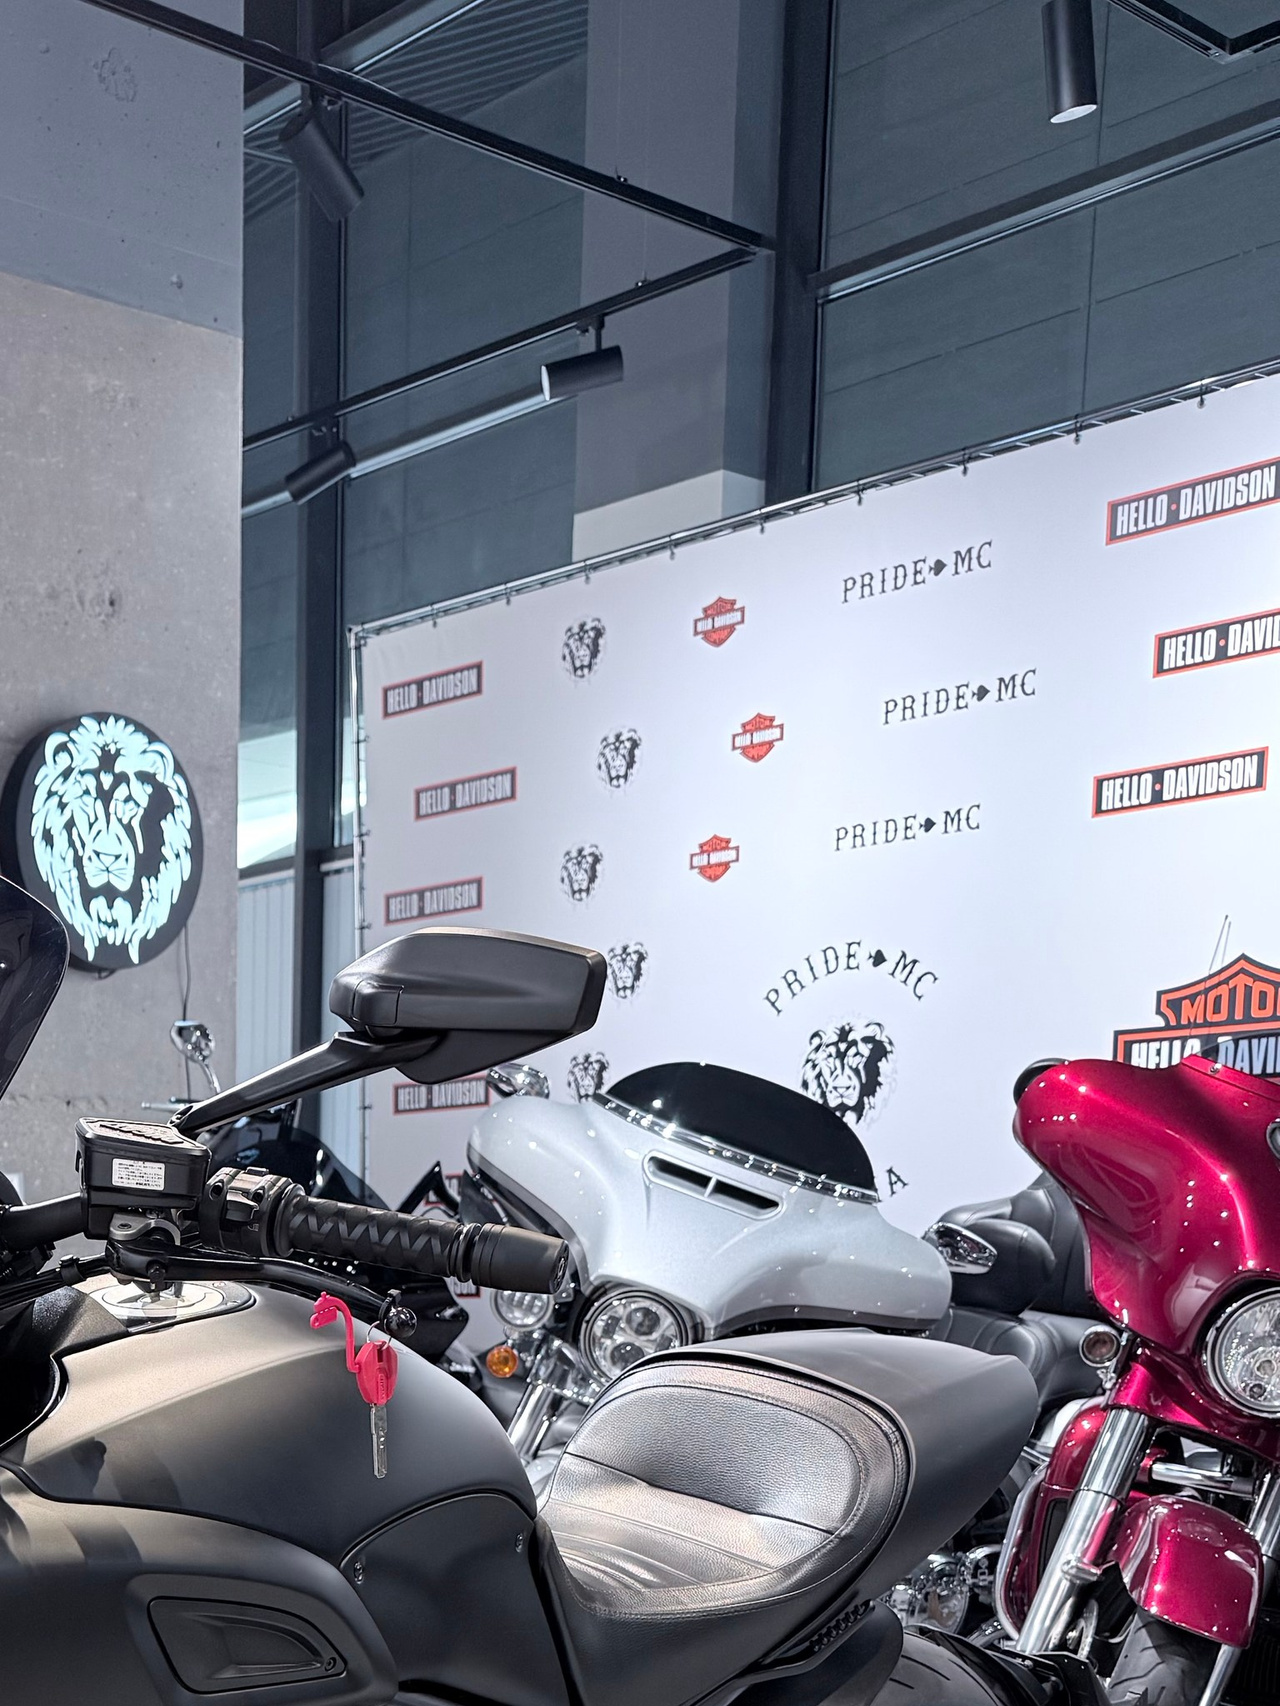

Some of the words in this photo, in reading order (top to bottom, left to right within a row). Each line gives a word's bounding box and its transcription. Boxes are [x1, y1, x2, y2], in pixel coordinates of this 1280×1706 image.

[1116, 494, 1168, 536] HELLO
[1179, 465, 1277, 520] DAVIDSON
[842, 556, 927, 604] PRIDE
[952, 539, 992, 577] MC
[1163, 629, 1217, 669] HELLO
[387, 683, 418, 714] HELLO
[422, 667, 478, 705] DAVIDSON
[883, 681, 970, 725] PRIDE
[995, 668, 1037, 702] MC
[419, 787, 451, 816] HELLO
[455, 772, 512, 808] DAVIDSON
[1101, 773, 1153, 811] HELLO
[1162, 754, 1258, 800] DAVIDSON
[834, 814, 917, 851] PRIDE
[941, 803, 981, 834] MC
[389, 893, 419, 921] HELLO
[423, 882, 478, 915] DAVIDSON
[763, 940, 862, 1017] PRIDE
[888, 950, 939, 1002] MC
[1181, 972, 1280, 1025] MOTO
[1217, 1036, 1280, 1075] DAVI
[431, 1079, 487, 1108] DAVIDSON
